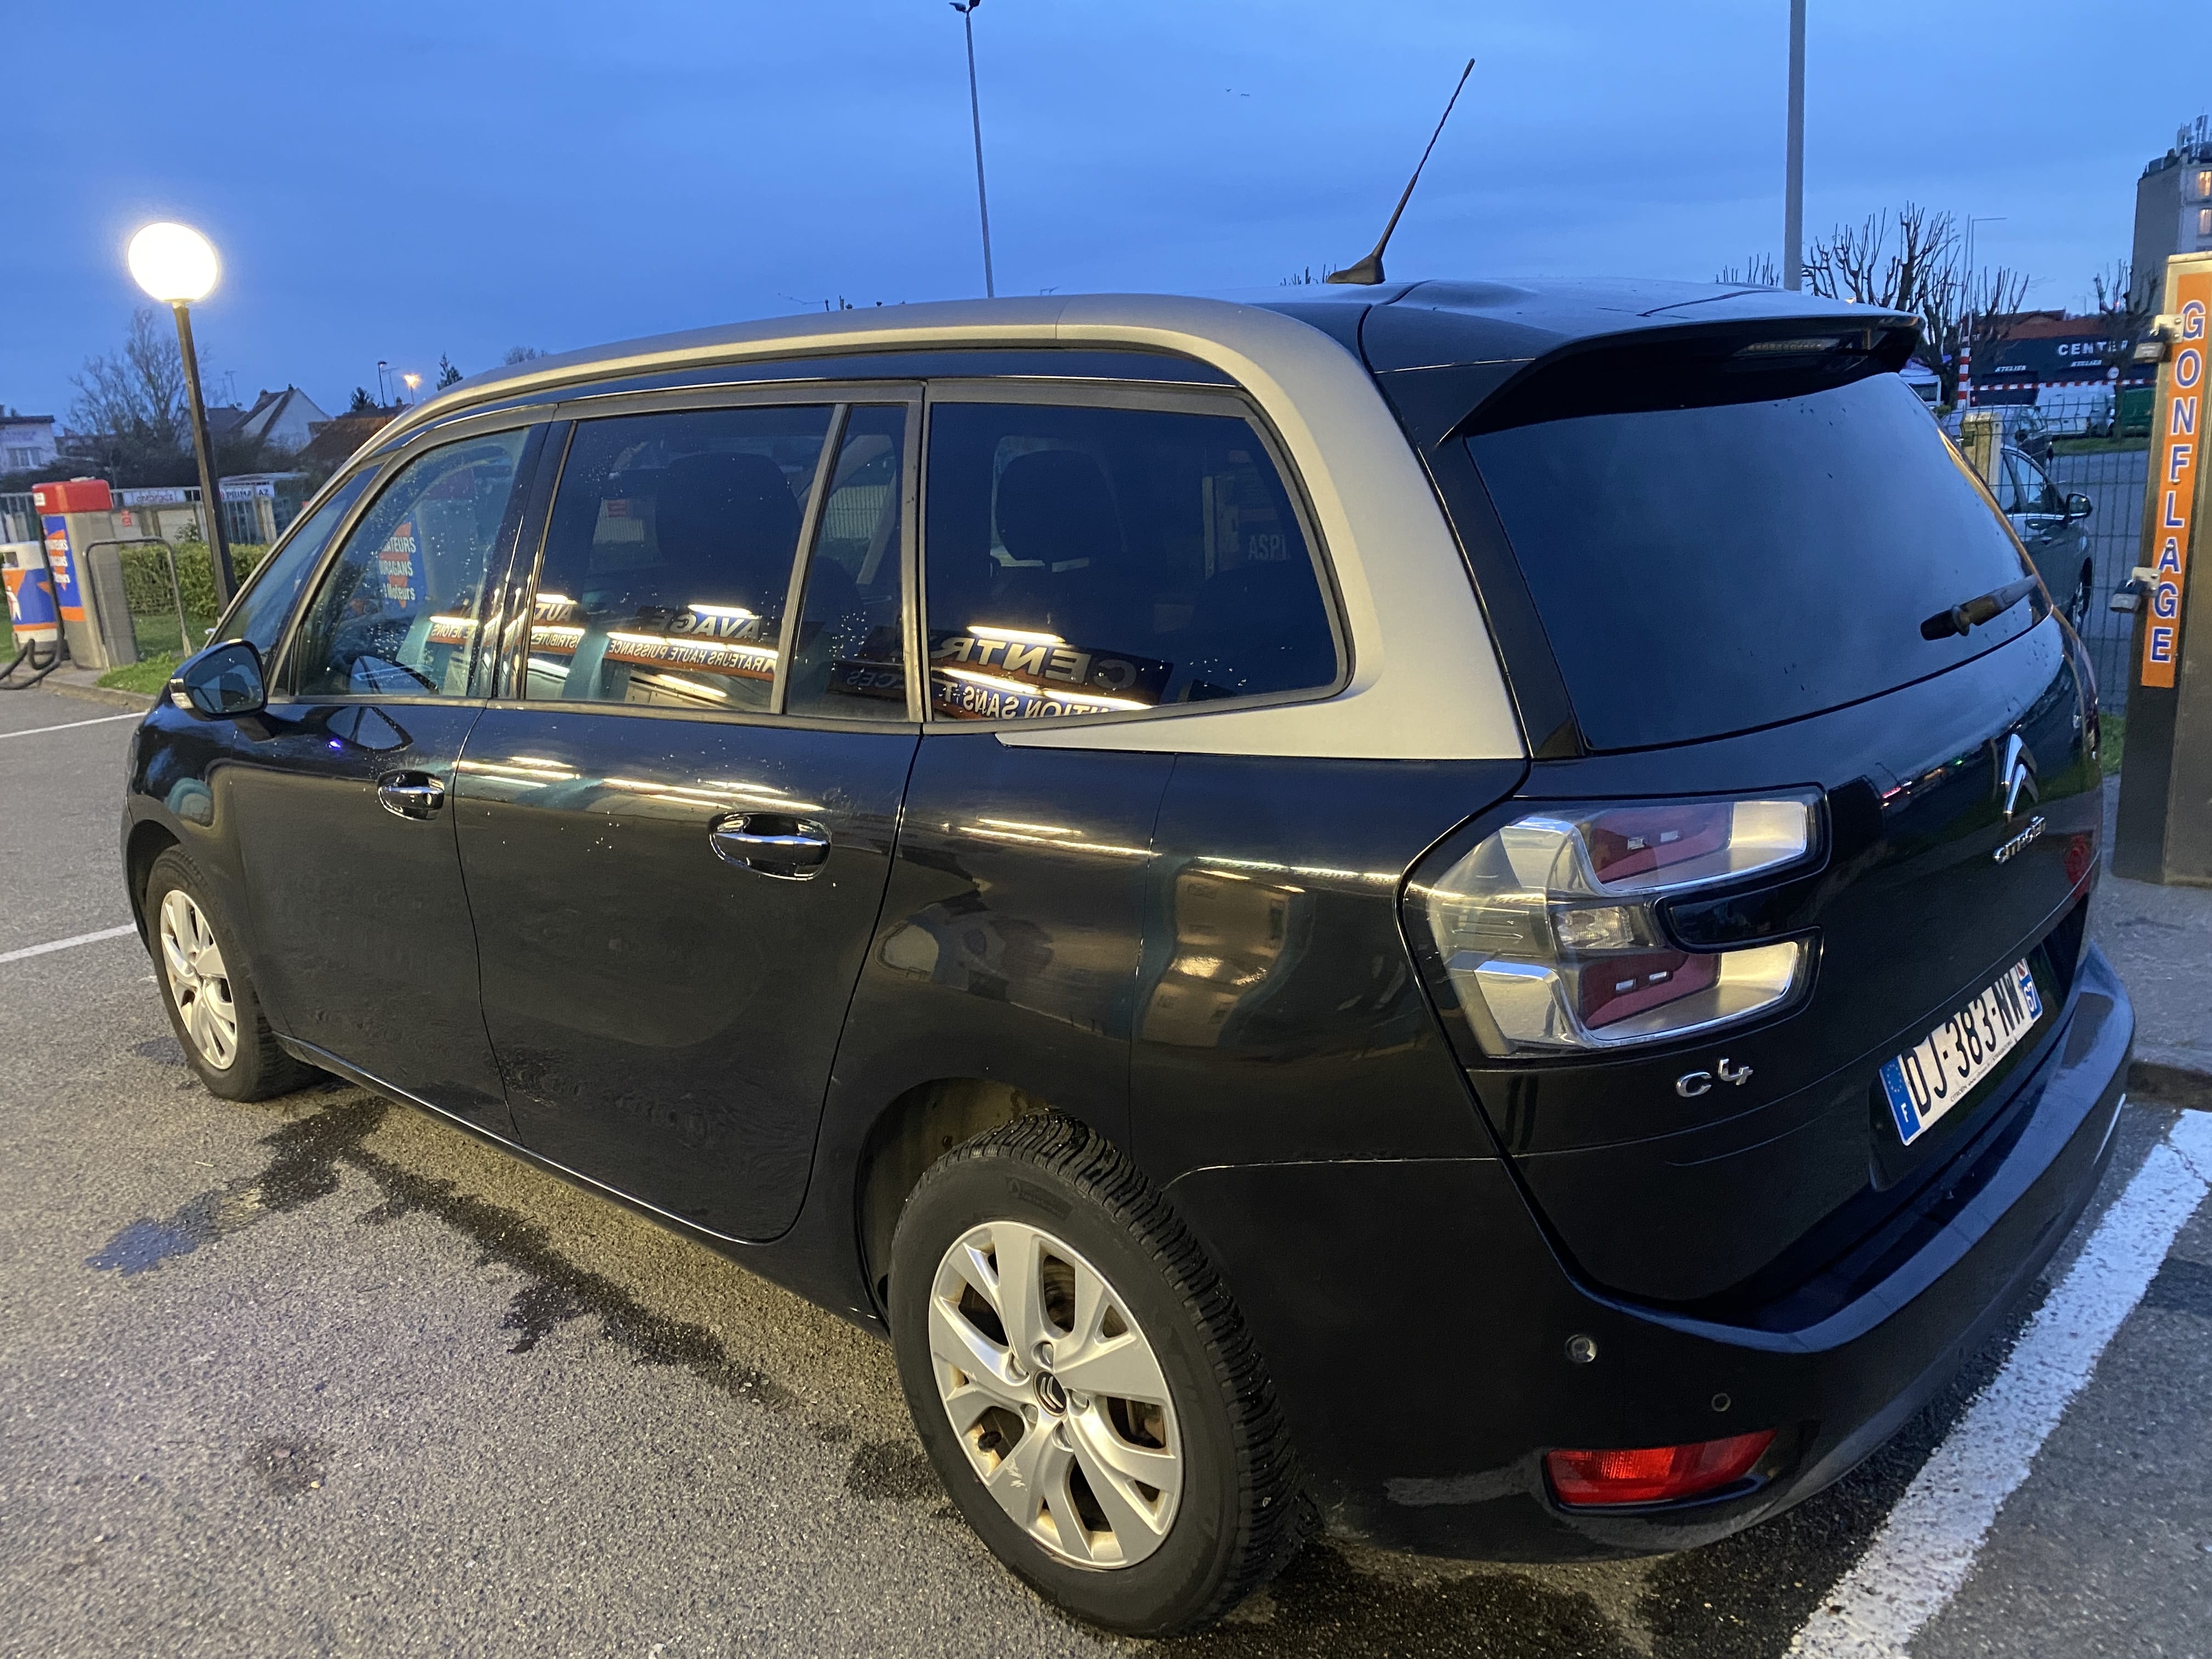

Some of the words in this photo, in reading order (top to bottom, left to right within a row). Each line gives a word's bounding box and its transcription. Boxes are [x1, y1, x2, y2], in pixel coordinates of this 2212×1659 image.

[2058, 340, 2128, 356] CENTER
[2150, 300, 2206, 663] GONFLAGE
[383, 537, 416, 554] ATEURS
[1248, 534, 1286, 560] ASPI
[2024, 981, 2038, 1012] 67
[1901, 969, 2025, 1117] DJ-383-NW
[1676, 1058, 1754, 1097] C4
[1900, 1102, 1909, 1123] F
